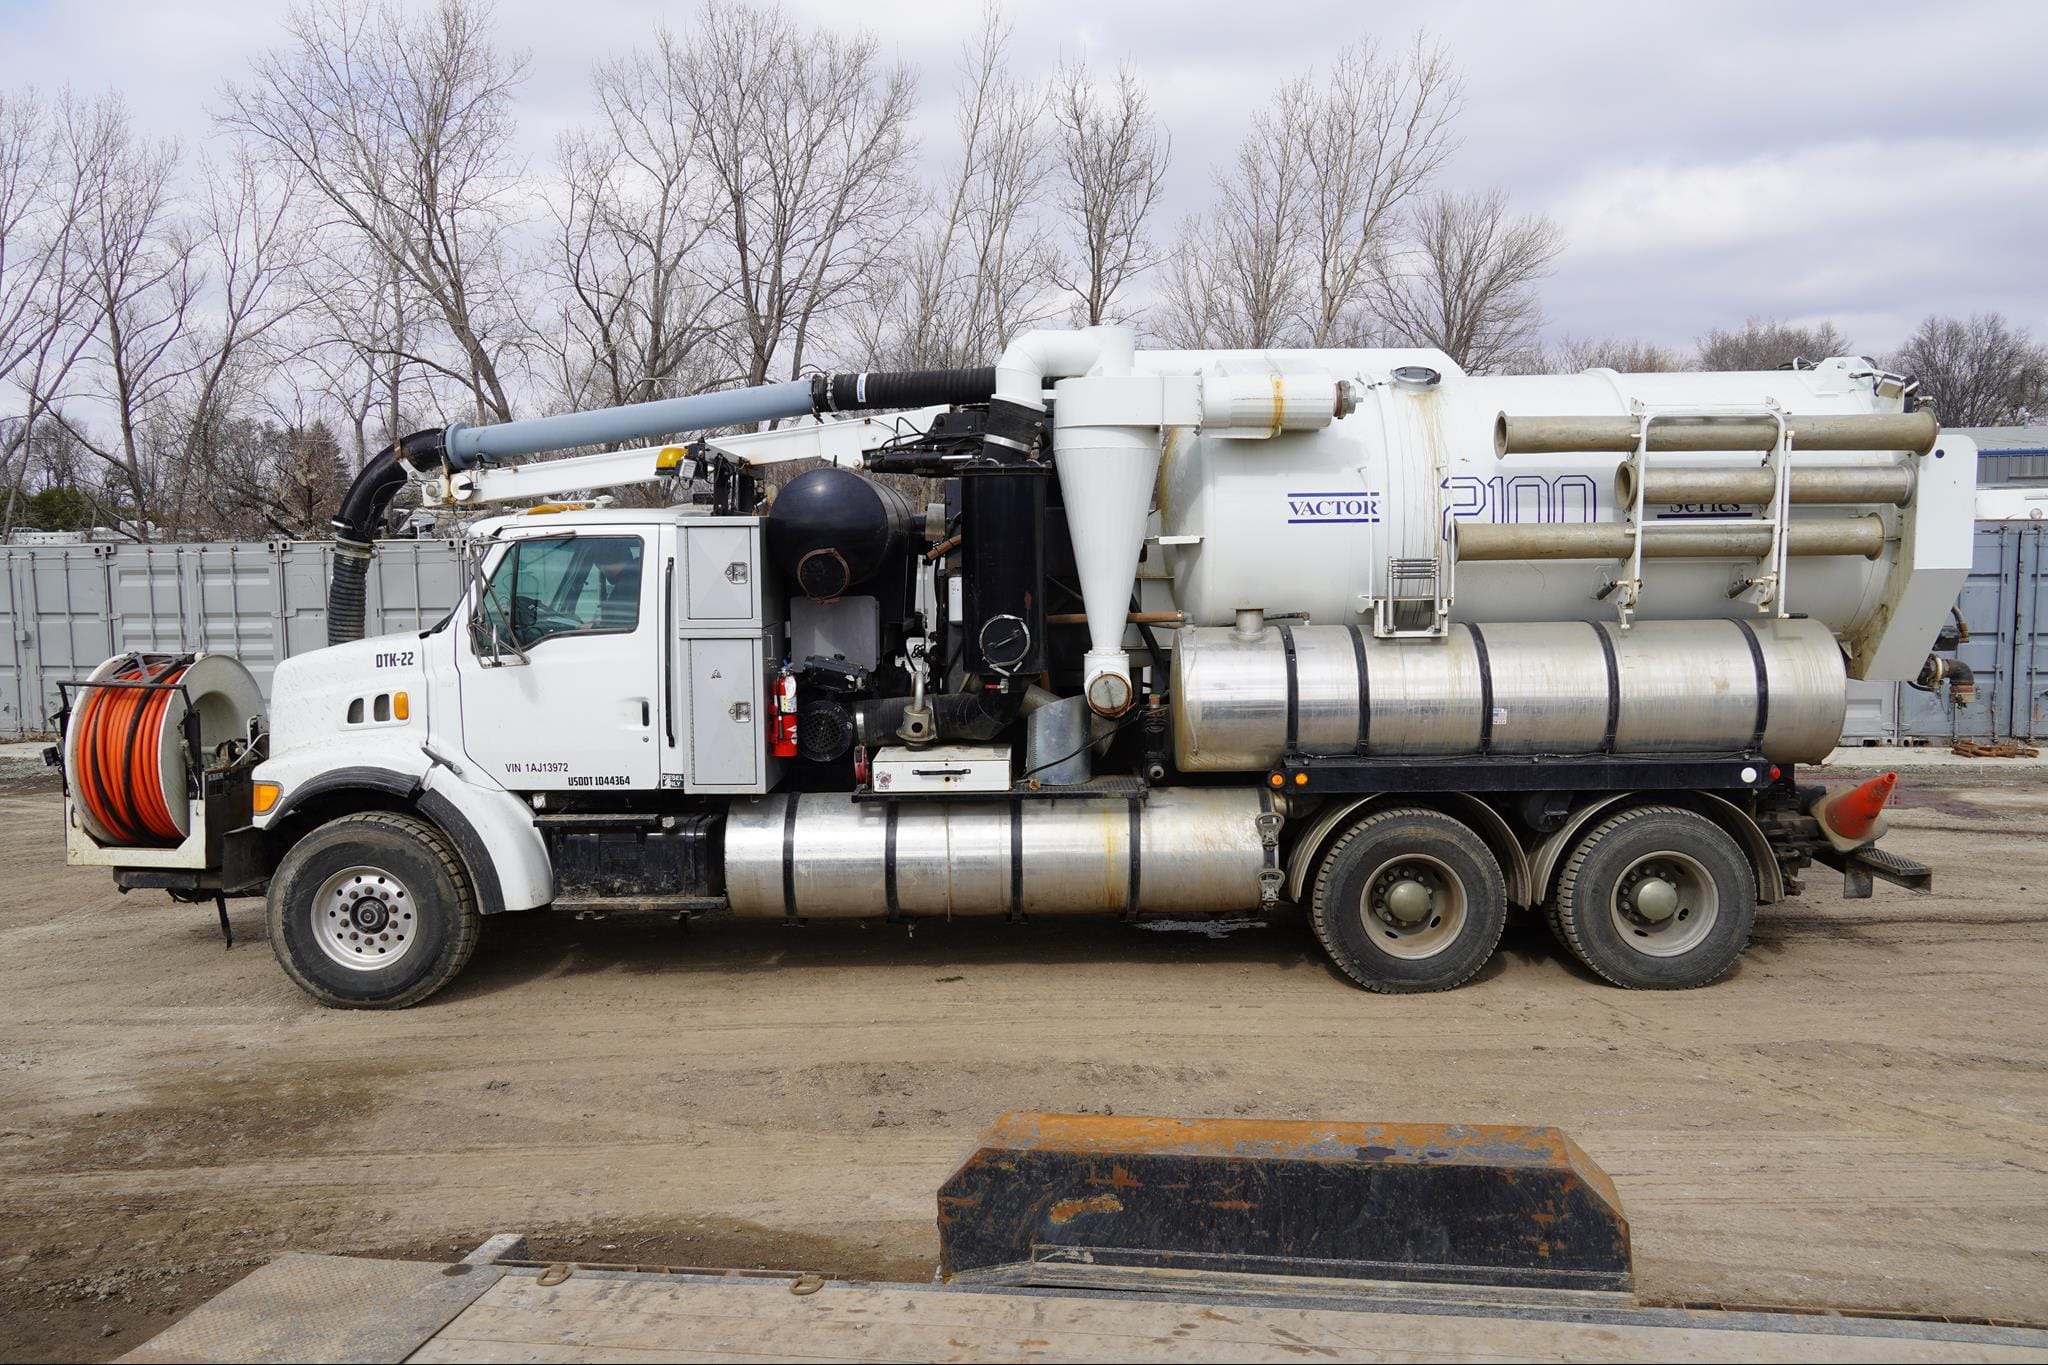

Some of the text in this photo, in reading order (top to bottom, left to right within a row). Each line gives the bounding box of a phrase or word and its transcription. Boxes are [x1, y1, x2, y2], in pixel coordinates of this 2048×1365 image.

[1288, 500, 1378, 516] VACTOR
[375, 651, 414, 668] DTK-22
[505, 762, 569, 773] VIN 1AJ13972
[568, 775, 631, 787] USDOT 1044364
